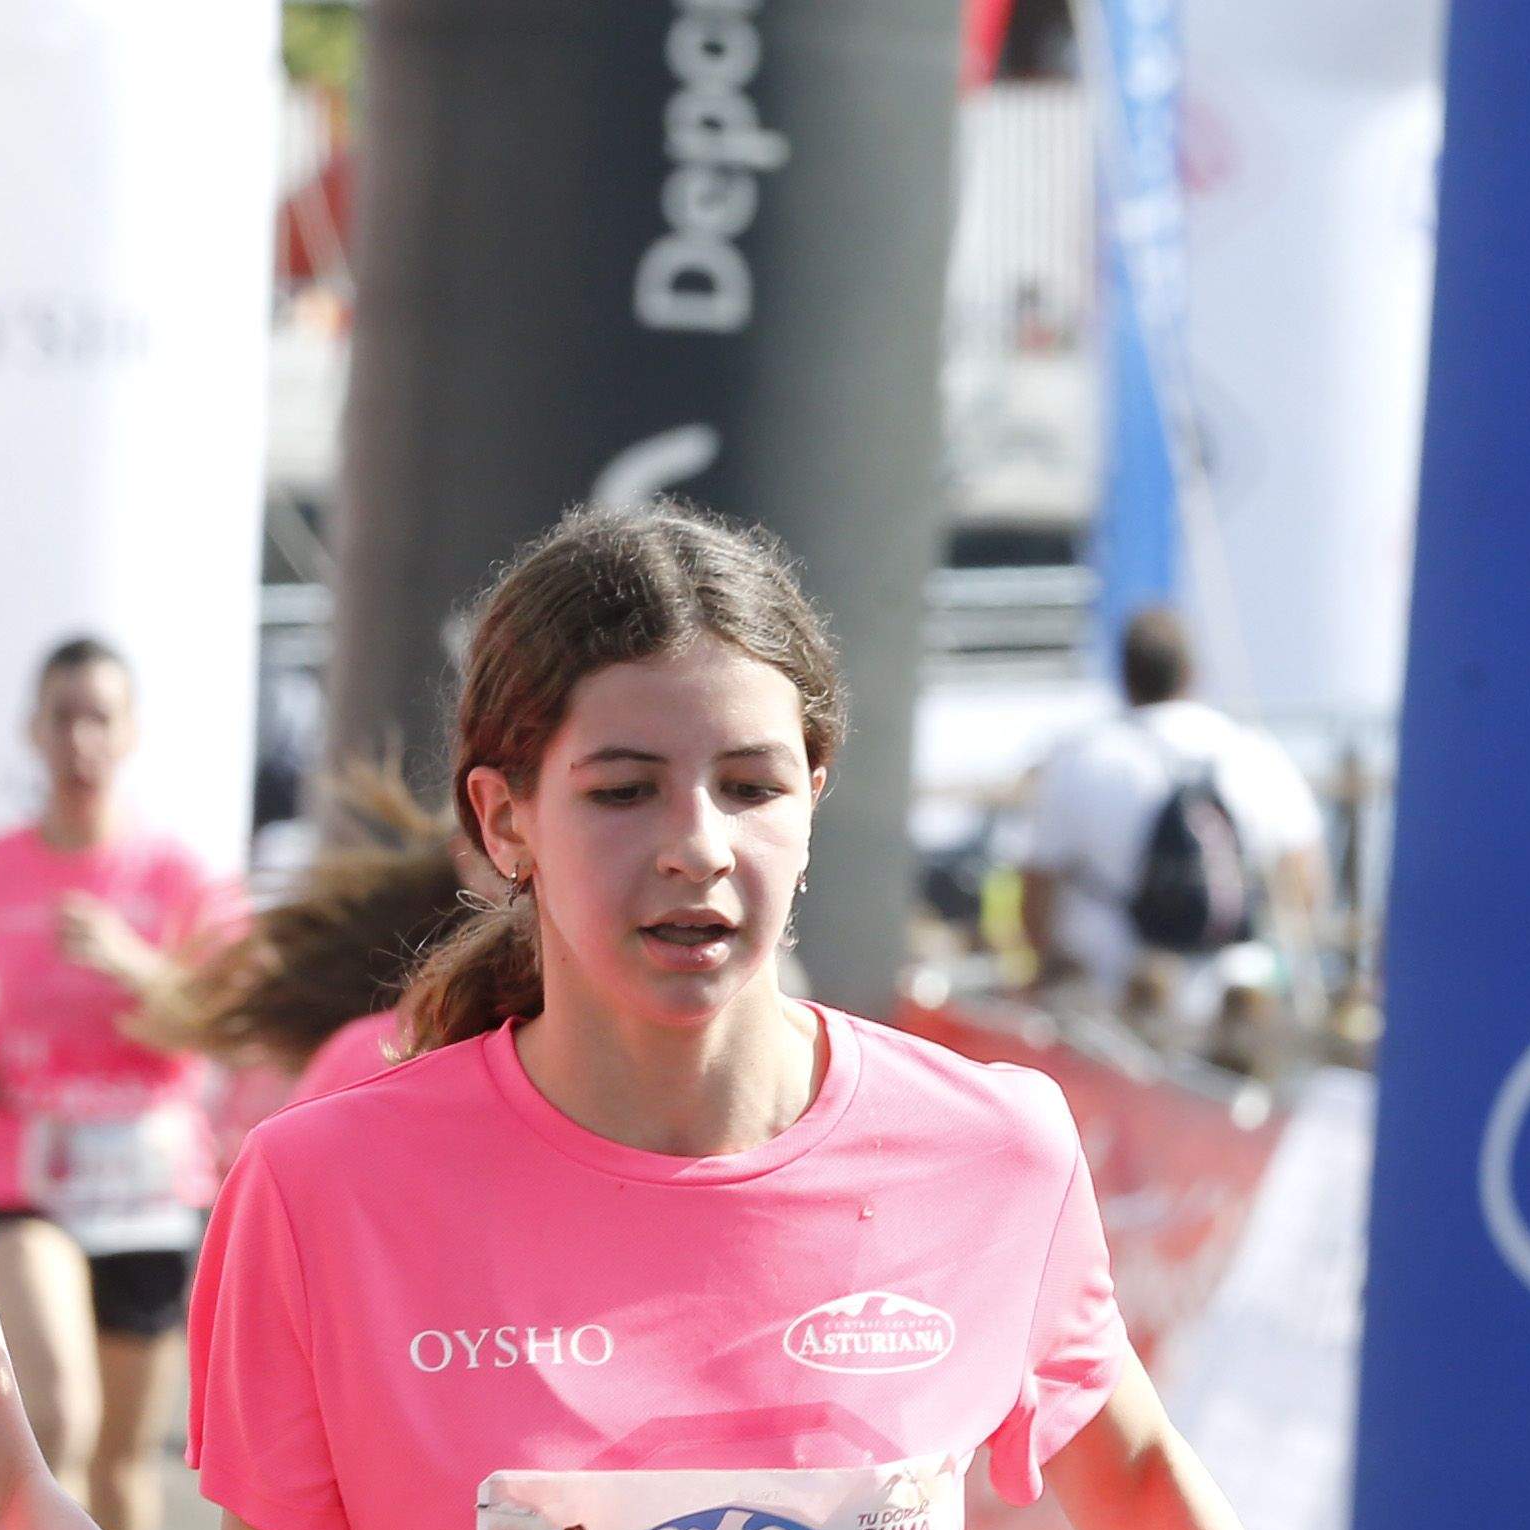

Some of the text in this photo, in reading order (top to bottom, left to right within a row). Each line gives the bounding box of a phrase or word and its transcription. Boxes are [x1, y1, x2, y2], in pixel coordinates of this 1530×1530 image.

[633, 0, 790, 333] Depo
[409, 1323, 615, 1373] OYSHO
[797, 1323, 944, 1357] ASTURIANA
[857, 1512, 879, 1527] TU
